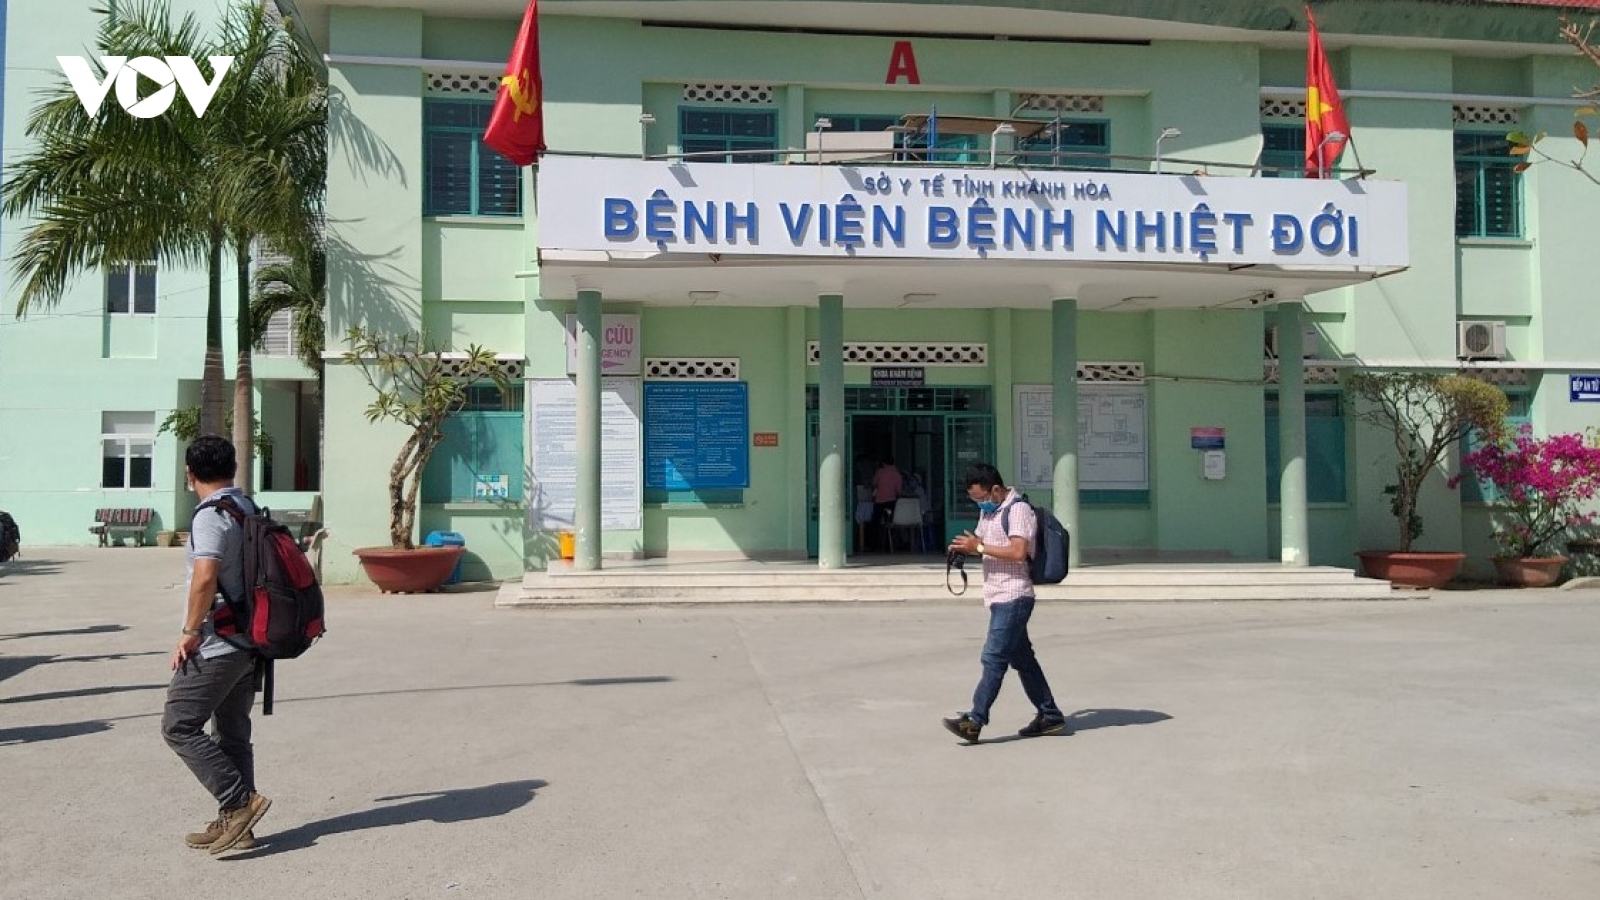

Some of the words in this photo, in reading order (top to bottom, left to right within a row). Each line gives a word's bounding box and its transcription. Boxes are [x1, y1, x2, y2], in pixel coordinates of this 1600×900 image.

[885, 40, 921, 85] A
[864, 171, 891, 194] SỞ
[899, 178, 912, 195] Y
[919, 173, 946, 197] TẾ
[952, 174, 995, 196] TỈNH
[1001, 177, 1066, 200] KHÁNH
[1073, 179, 1112, 200] HÒA
[604, 189, 756, 249] BỆNH
[779, 194, 904, 253] VIỆN
[928, 197, 1072, 257] BỆNH
[1096, 202, 1252, 260] NHIỆT
[1272, 202, 1359, 255] ĐỚI
[605, 323, 634, 344] CỨU
